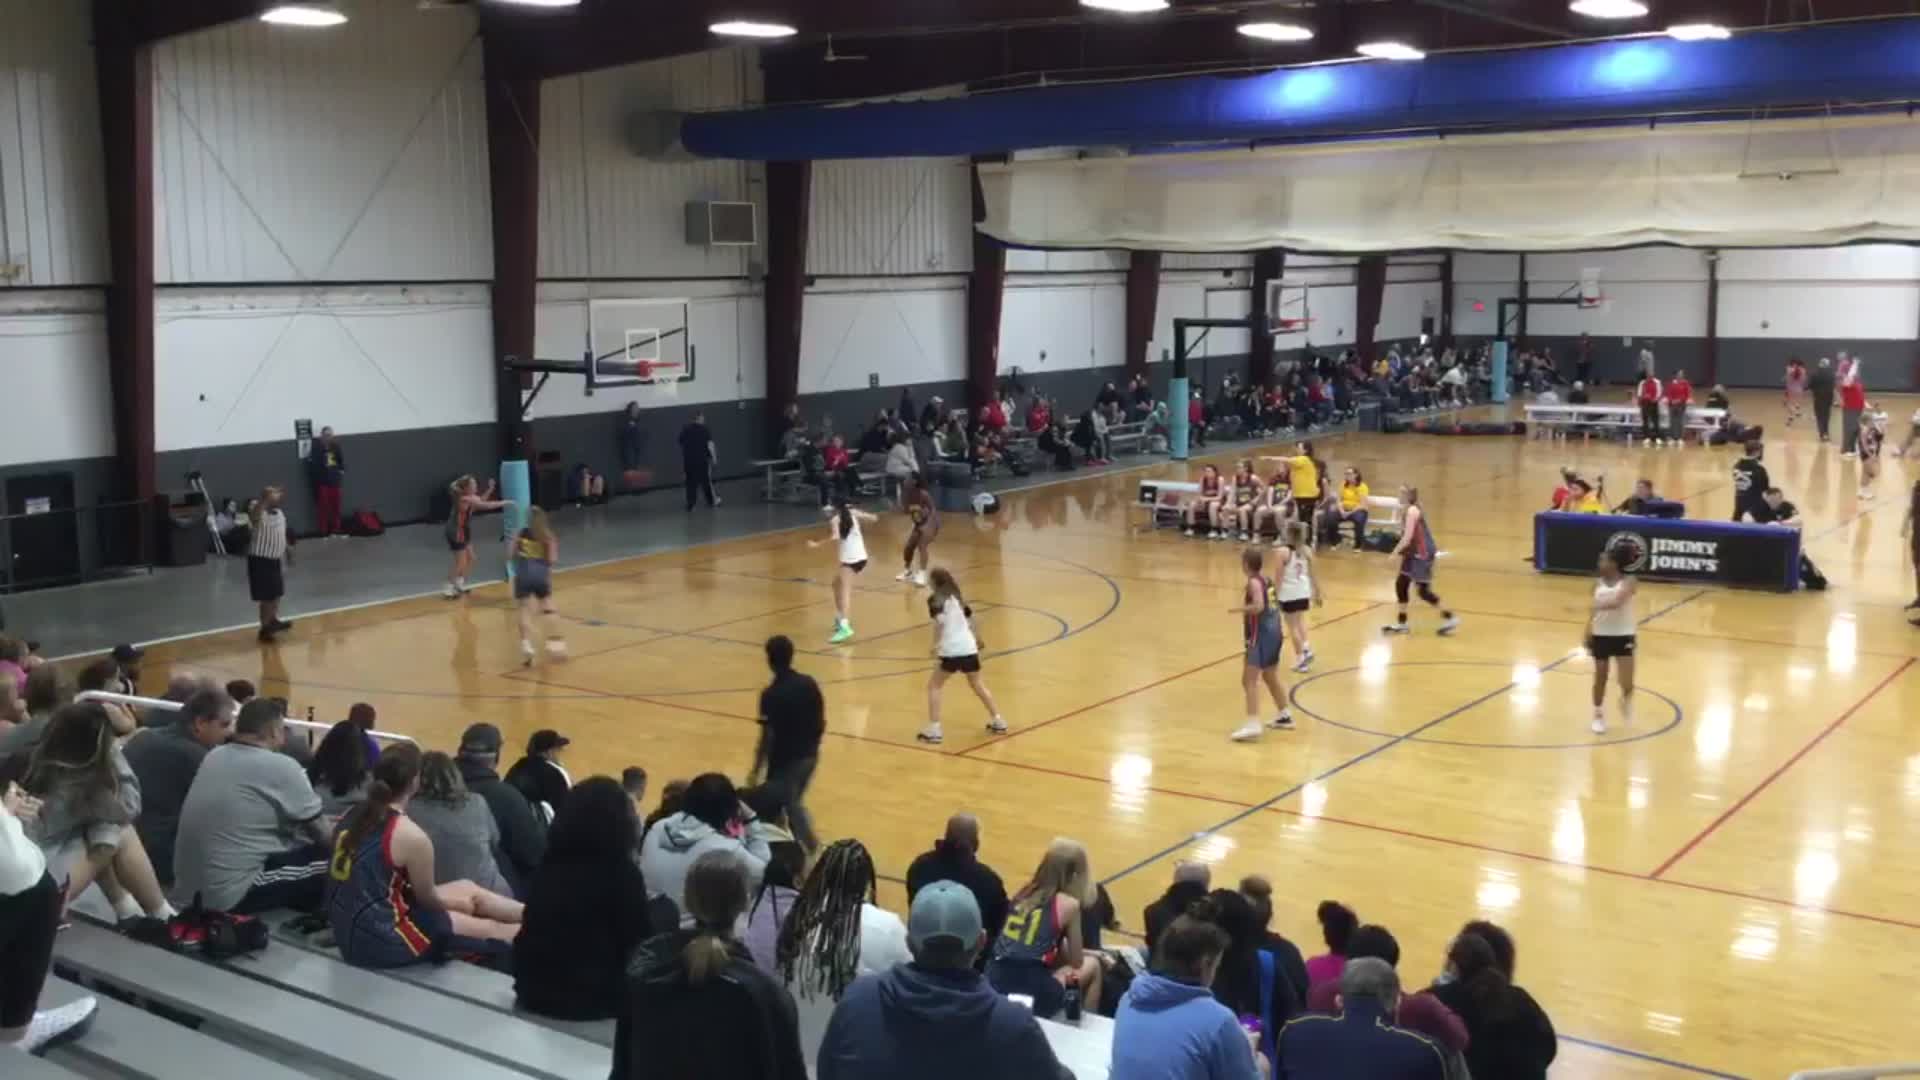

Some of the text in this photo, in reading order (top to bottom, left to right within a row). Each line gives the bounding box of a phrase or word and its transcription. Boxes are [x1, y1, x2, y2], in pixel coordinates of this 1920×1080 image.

[1651, 538, 1718, 555] JIMMY
[1649, 555, 1720, 572] JOHN'S
[1002, 908, 1043, 946] 21
